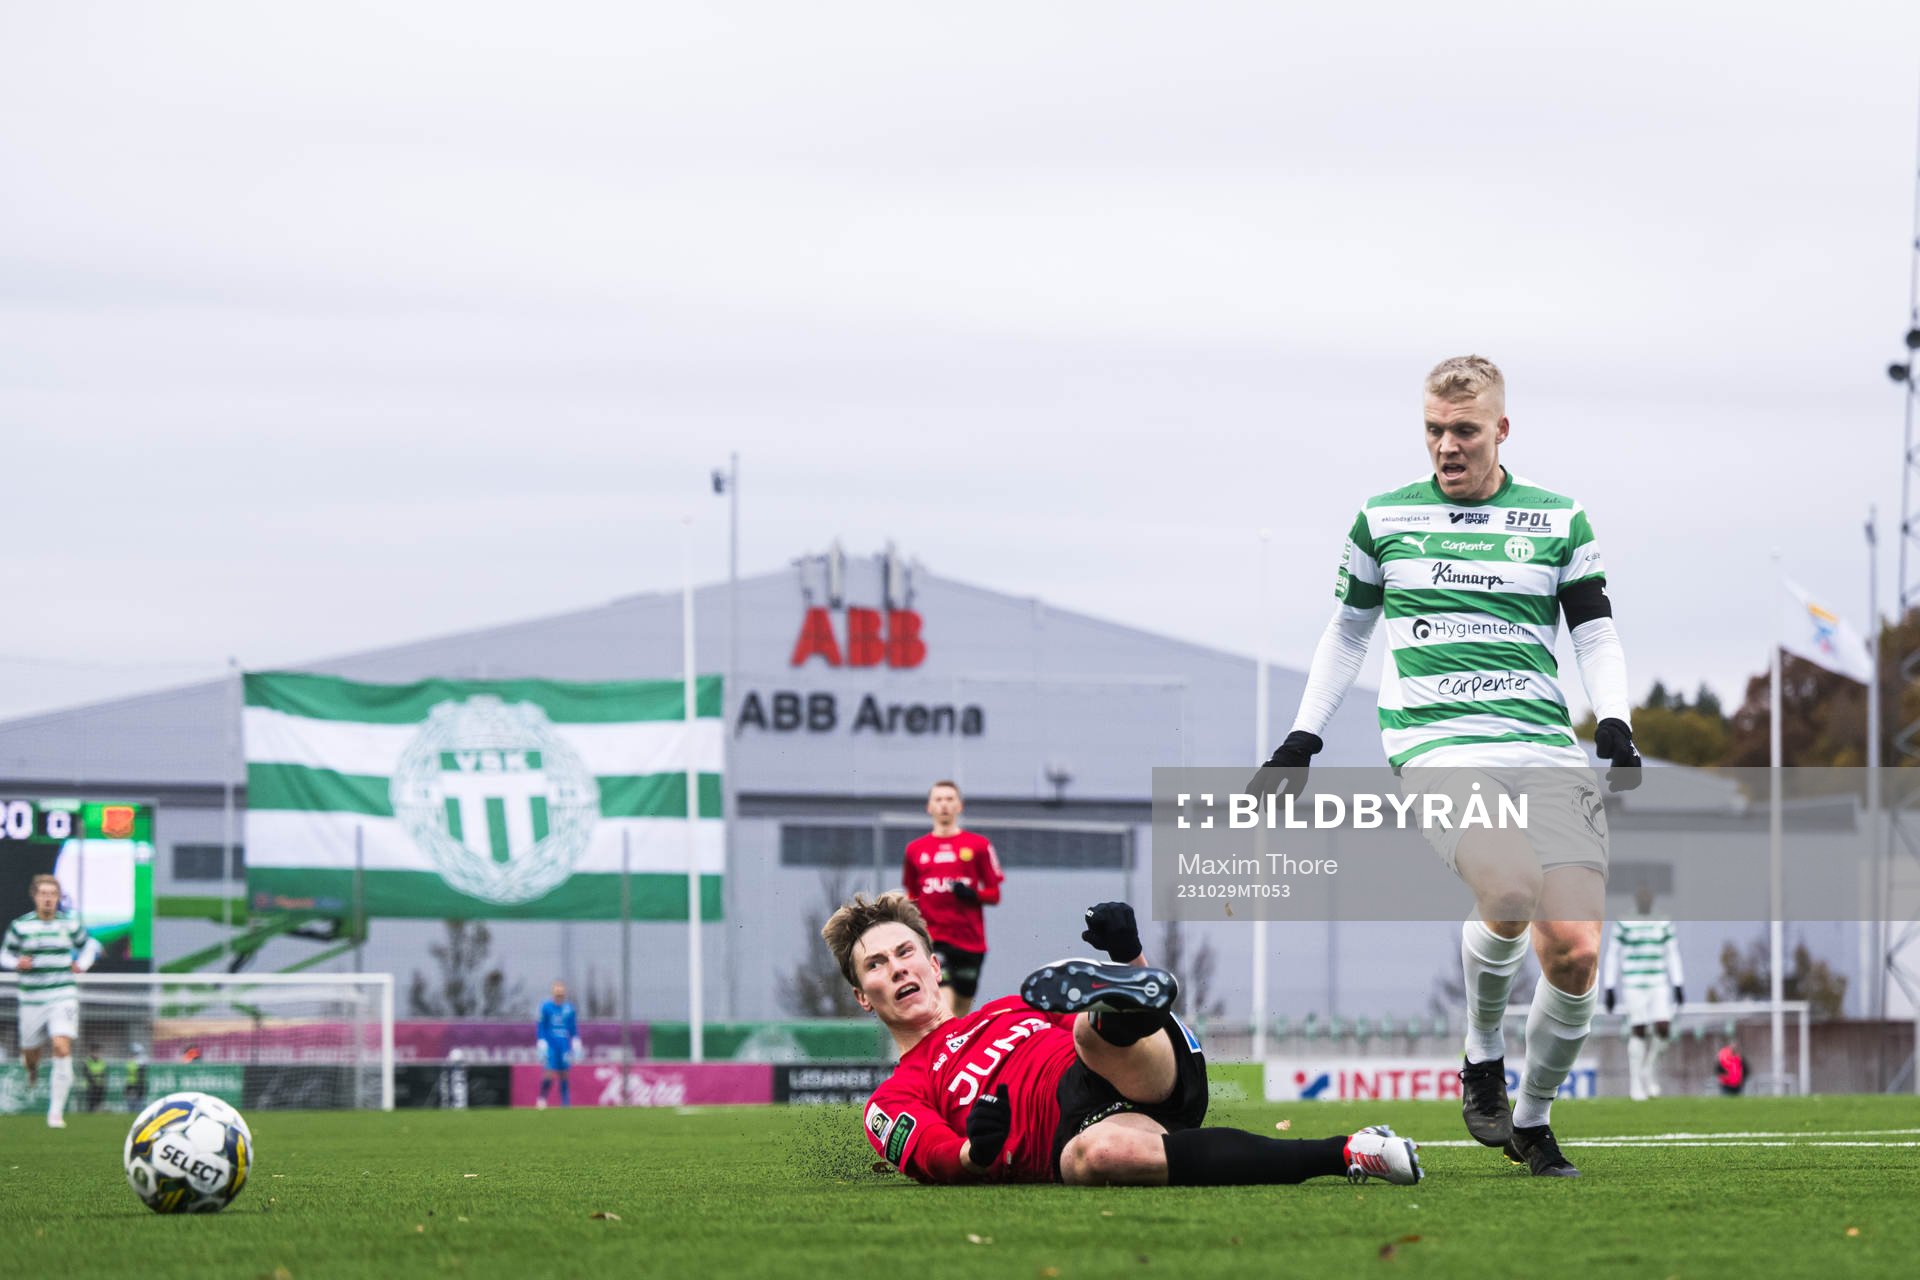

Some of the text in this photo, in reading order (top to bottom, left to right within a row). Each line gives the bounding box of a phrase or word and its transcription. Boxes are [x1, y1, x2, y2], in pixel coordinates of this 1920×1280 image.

[1505, 511, 1552, 526] SPOL
[1431, 561, 1514, 590] Kinnarps
[790, 606, 928, 668] ABB
[737, 690, 984, 736] ABB Arena
[454, 752, 529, 770] VSK
[1337, 1070, 1598, 1100] INTERPRT
[888, 1117, 908, 1161] UNIBET
[160, 1144, 223, 1185] SELECT
